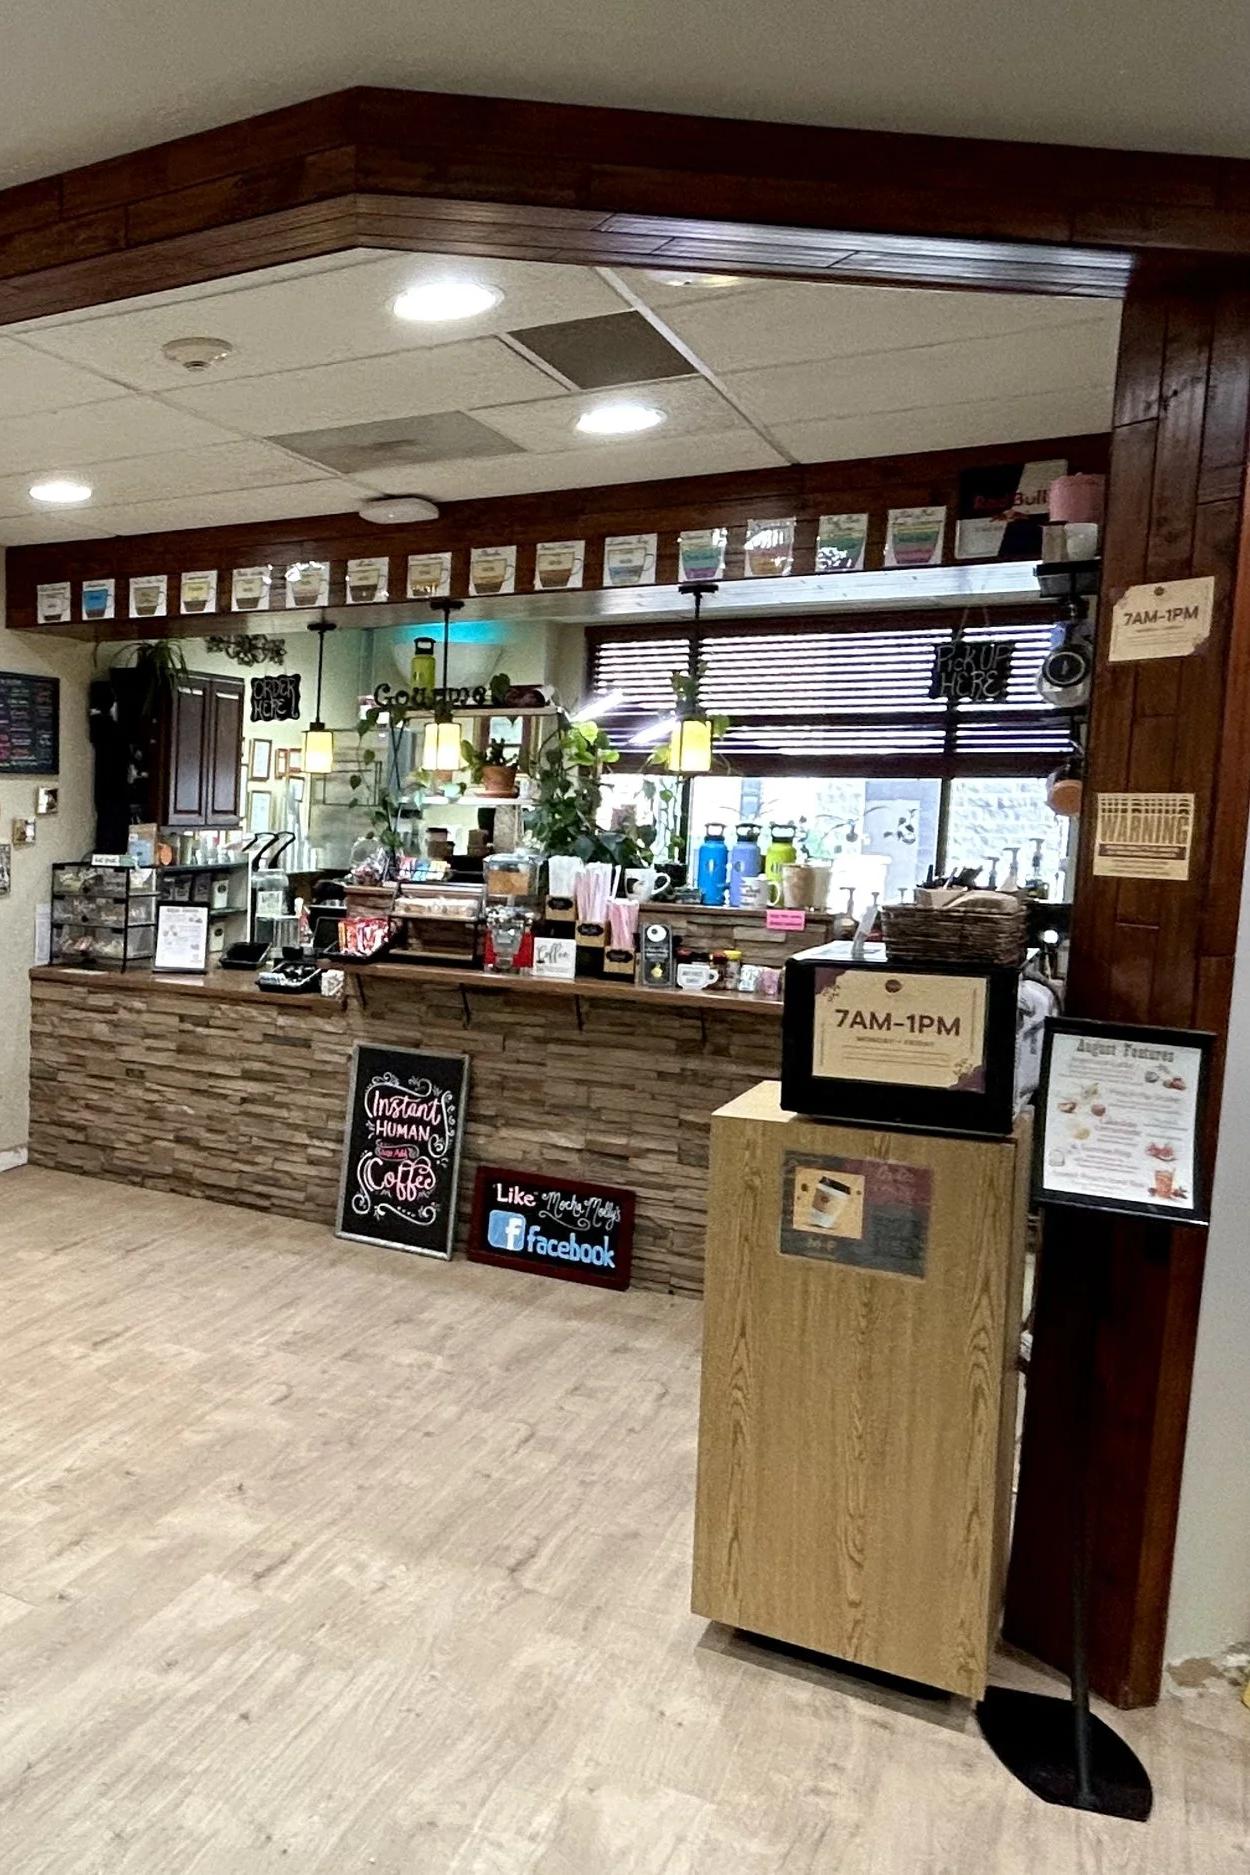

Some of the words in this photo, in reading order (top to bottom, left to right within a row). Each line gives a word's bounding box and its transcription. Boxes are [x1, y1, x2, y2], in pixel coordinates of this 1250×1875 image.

[1123, 605, 1199, 626] 7AM-1PM
[374, 683, 488, 707] Gourme
[940, 671, 1001, 698] HERE
[253, 699, 287, 720] HERE
[835, 1008, 961, 1037] 7AM-1PM
[372, 1090, 441, 1126] Instant
[375, 1119, 430, 1142] HUMAN
[363, 1156, 436, 1201] Coffee
[541, 1191, 585, 1218] Mocha
[526, 1225, 616, 1269] facebook
